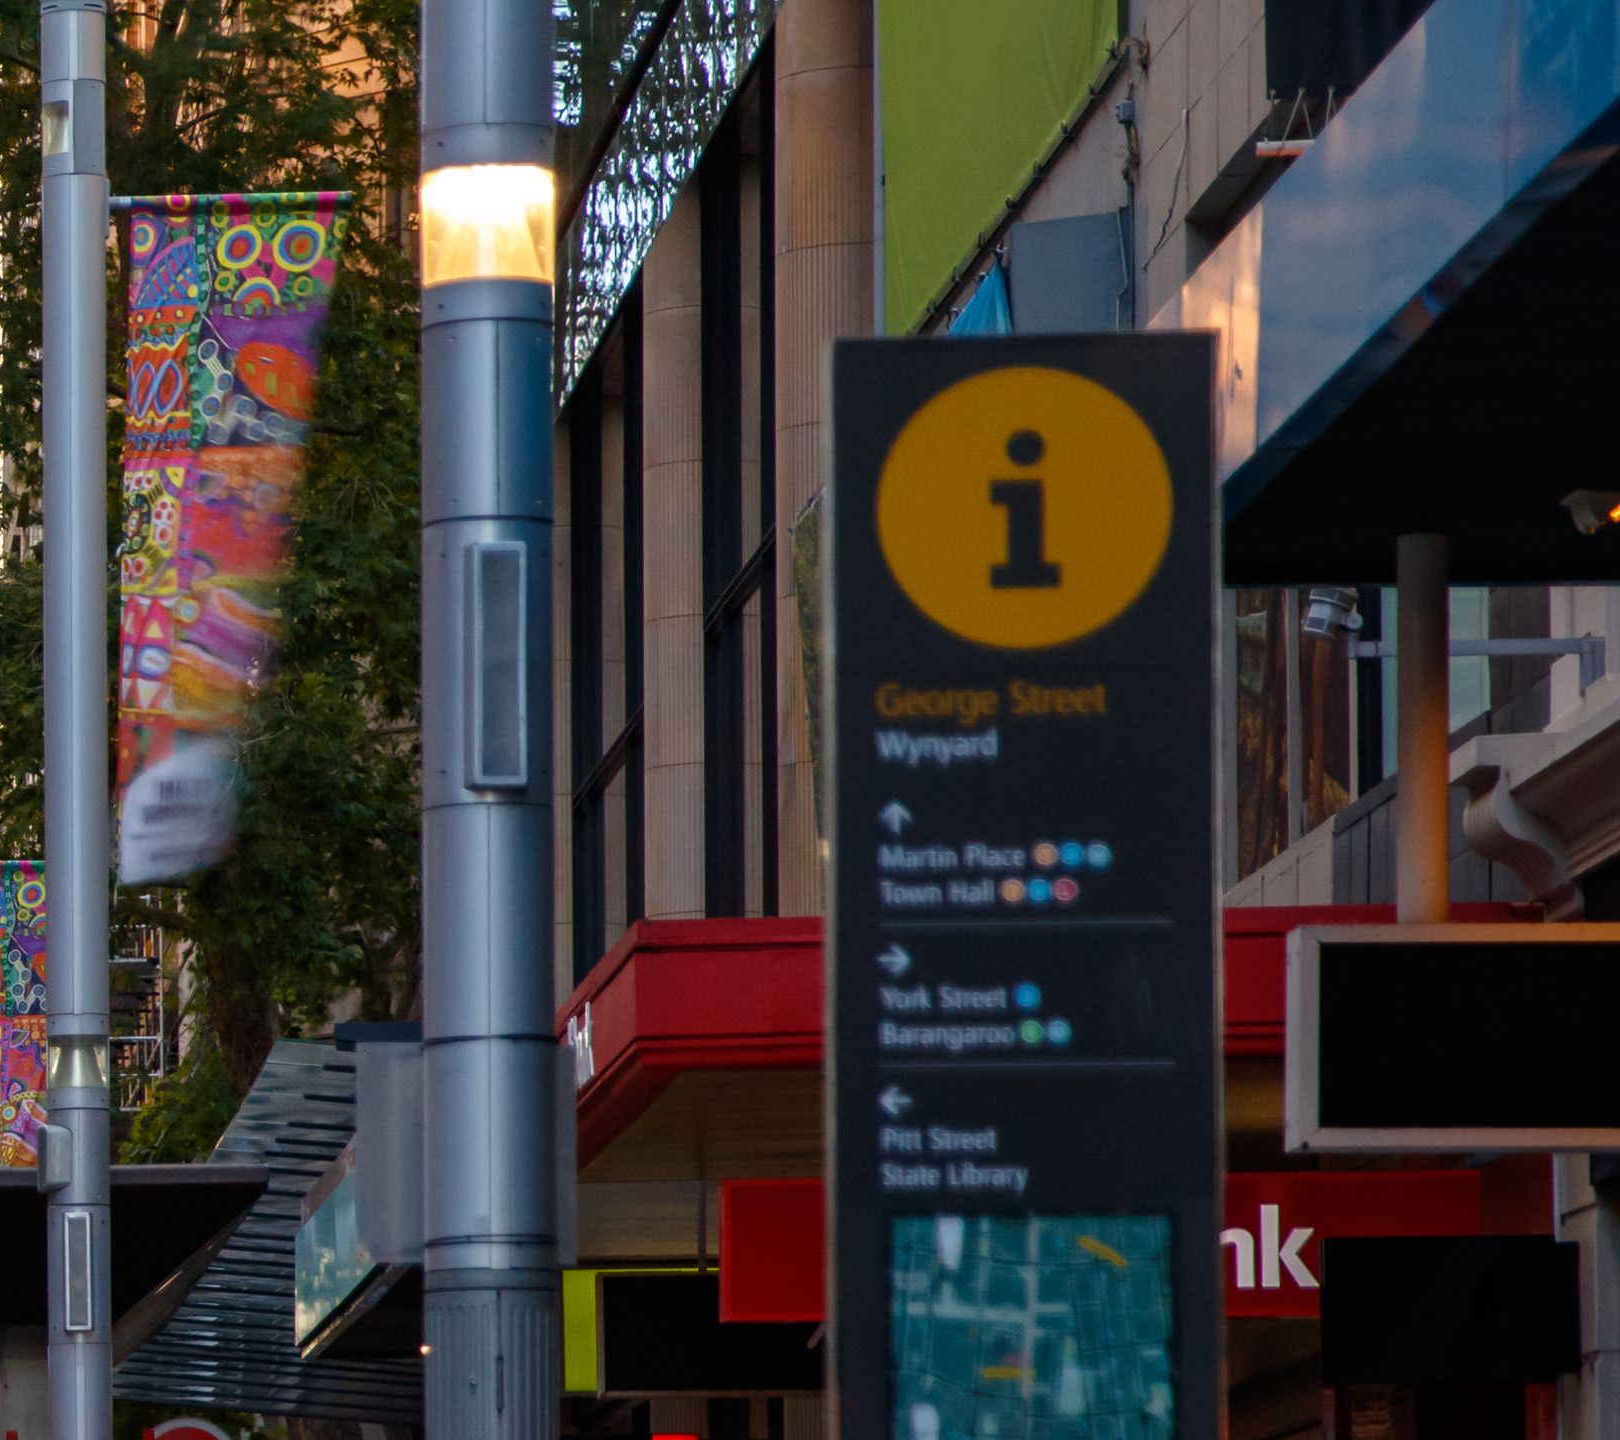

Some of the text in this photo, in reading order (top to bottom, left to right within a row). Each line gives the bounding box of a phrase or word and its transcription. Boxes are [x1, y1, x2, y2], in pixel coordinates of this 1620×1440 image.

[875, 680, 1107, 726] George Street
[875, 729, 998, 765] Wynyard
[878, 844, 958, 869] Martin
[964, 843, 1026, 868] Place
[880, 880, 942, 905] Town
[948, 879, 995, 904] Hall
[880, 985, 1007, 1009] York Street
[879, 1021, 1015, 1051] Barangaroo
[928, 1127, 997, 1151] Street
[881, 1163, 1029, 1193] State Library
[1219, 1204, 1319, 1288] nk
